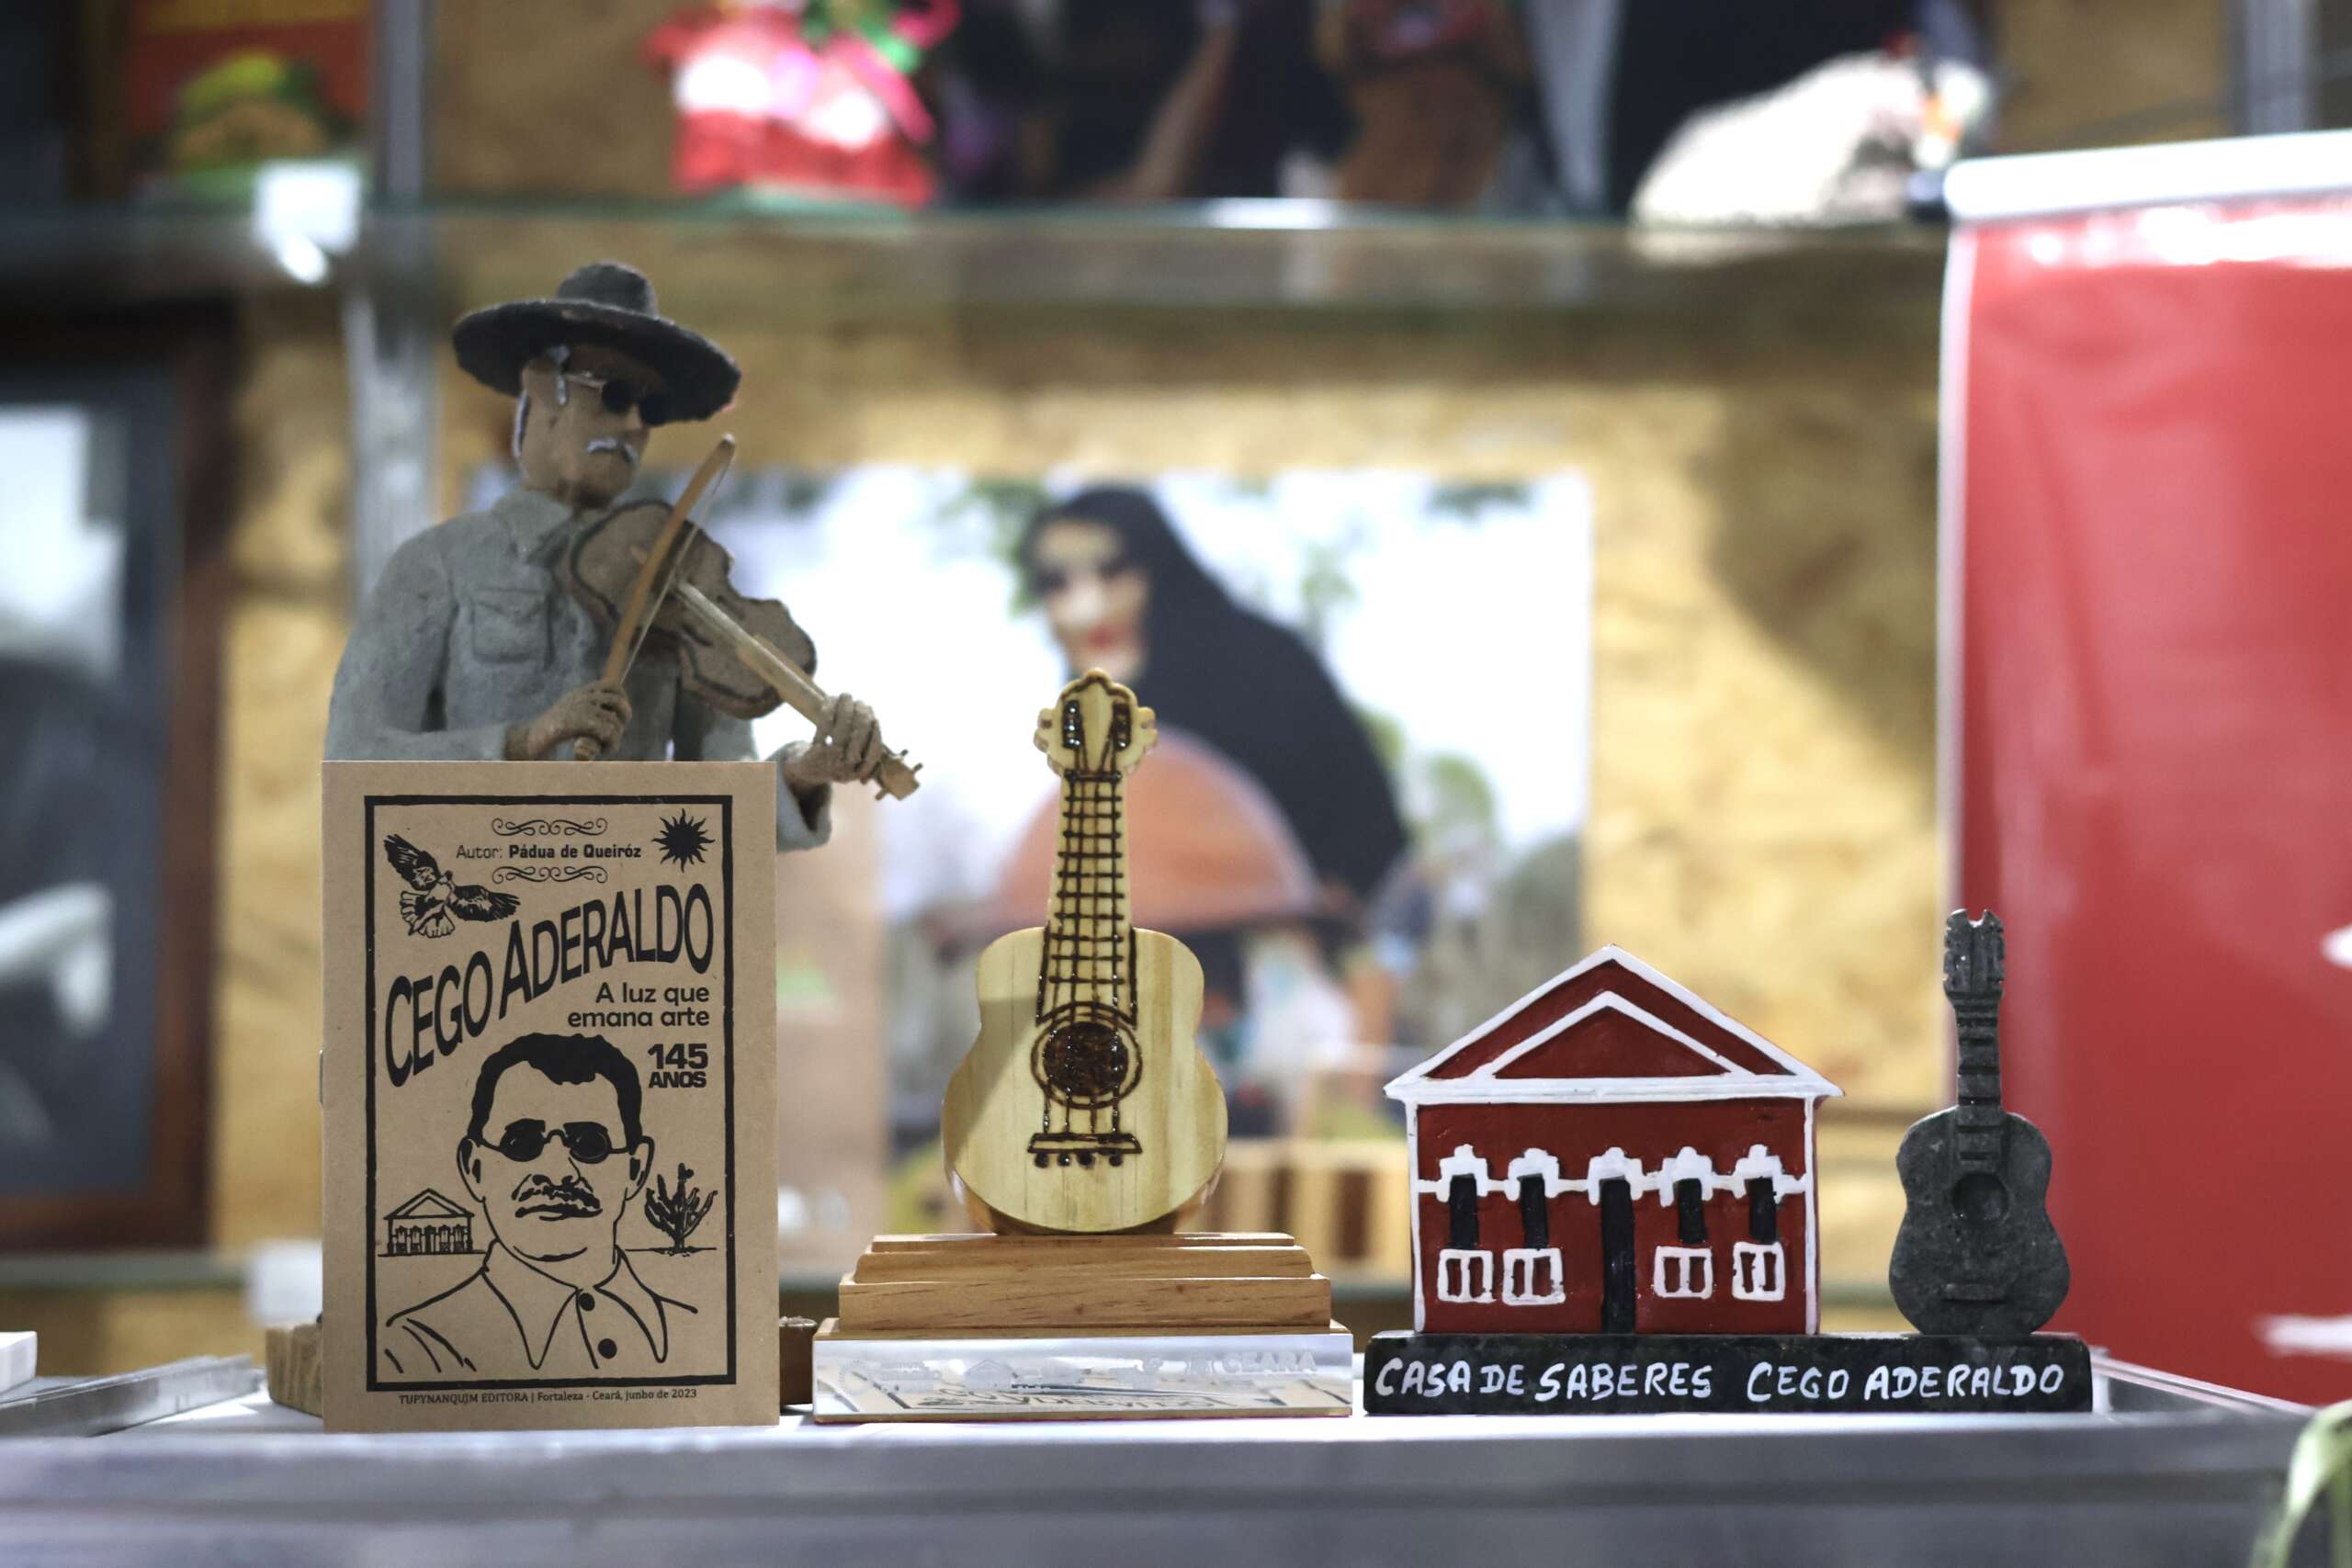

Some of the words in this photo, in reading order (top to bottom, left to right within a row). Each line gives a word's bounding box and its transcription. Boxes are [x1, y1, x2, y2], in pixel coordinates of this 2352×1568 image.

[456, 844, 503, 860] Autor:
[509, 843, 555, 859] Pádua
[560, 844, 578, 858] de
[583, 842, 641, 859] Queiróz
[385, 952, 493, 1087] CEGO
[499, 883, 715, 1020] ADERALDO
[595, 982, 615, 1003] A
[623, 981, 656, 1003] luz
[663, 987, 709, 1010] que
[568, 1011, 652, 1028] emana
[660, 1009, 709, 1028] arte
[647, 1043, 708, 1069] 145
[649, 1071, 707, 1089] ANOS
[1375, 1358, 1471, 1397] CASA
[1479, 1364, 1524, 1395] DE
[1534, 1361, 1713, 1401] SABERES
[1747, 1361, 1849, 1403] CEGO
[1863, 1363, 2064, 1401] ADERALDO
[481, 1392, 528, 1404] EDITORA
[537, 1390, 583, 1402] Fortaleza
[593, 1389, 624, 1402] Ceará,
[625, 1388, 654, 1402] junho
[656, 1388, 669, 1400] de
[672, 1387, 698, 1400] 2023
